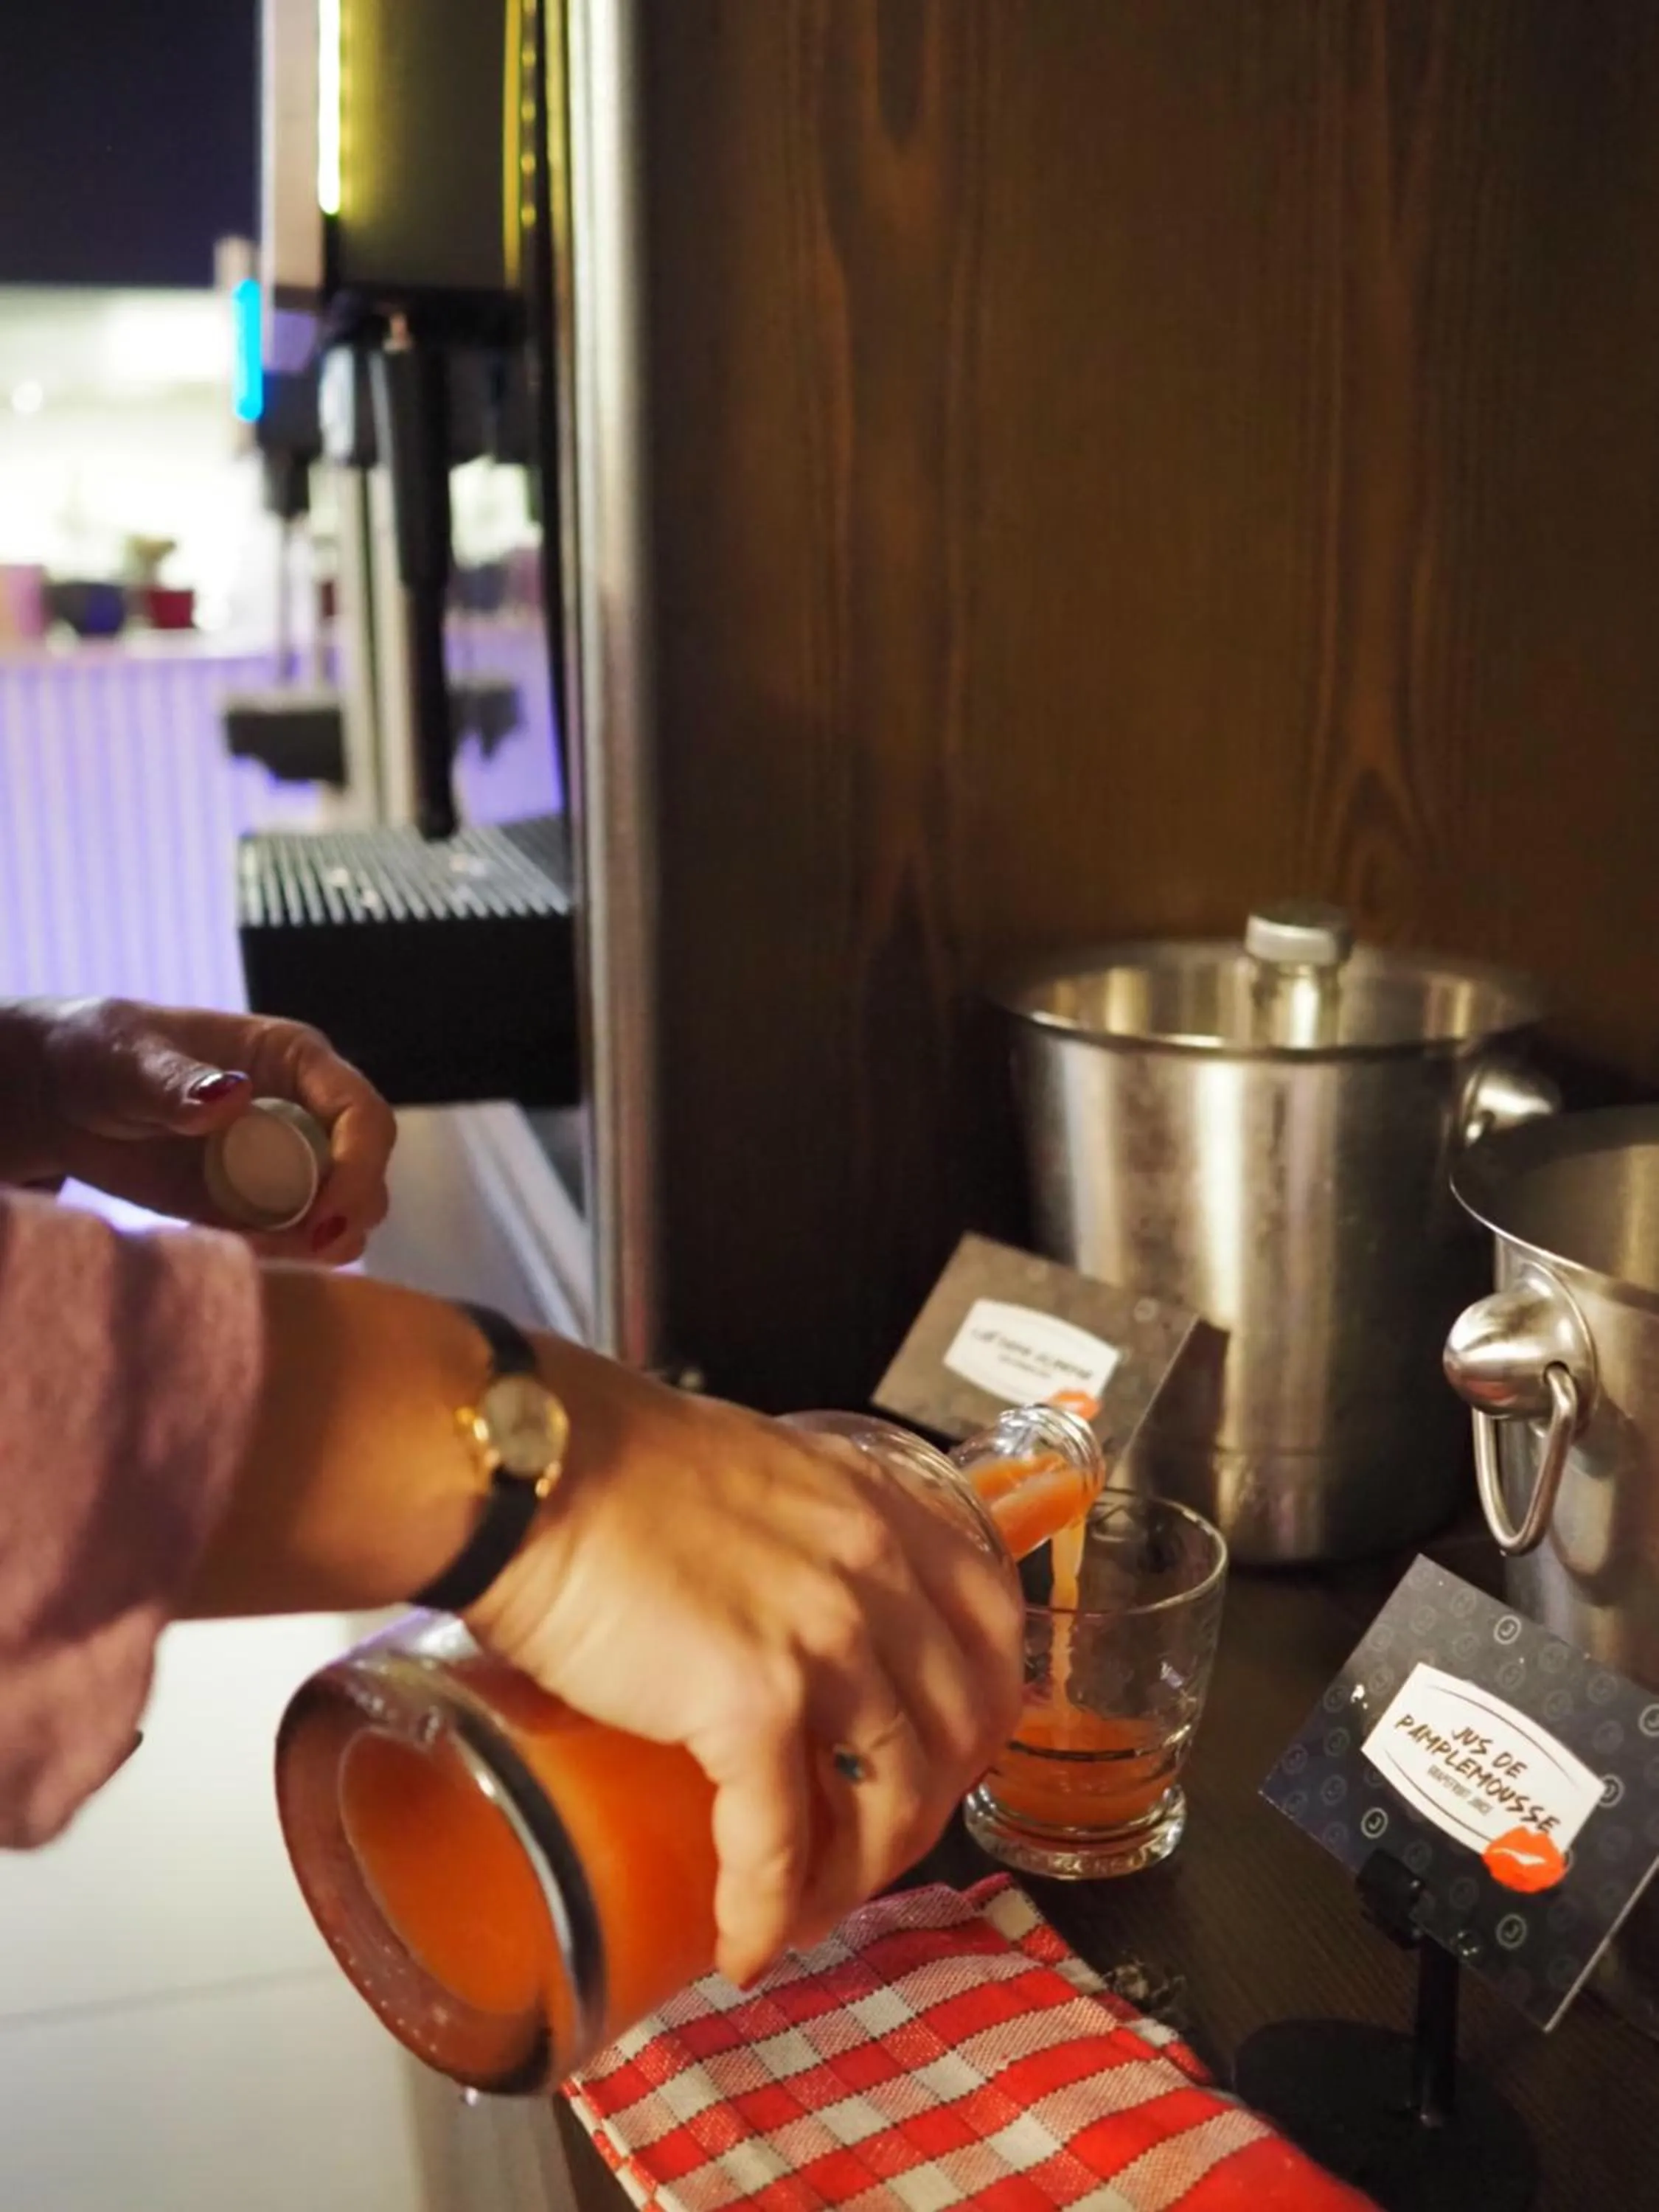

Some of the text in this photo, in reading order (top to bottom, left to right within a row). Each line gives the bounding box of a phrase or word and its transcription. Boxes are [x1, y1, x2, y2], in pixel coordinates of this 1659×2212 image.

[1394, 1714, 1561, 1833] PAMPLEMOUSSE
[1452, 1727, 1528, 1778] JUS DE
